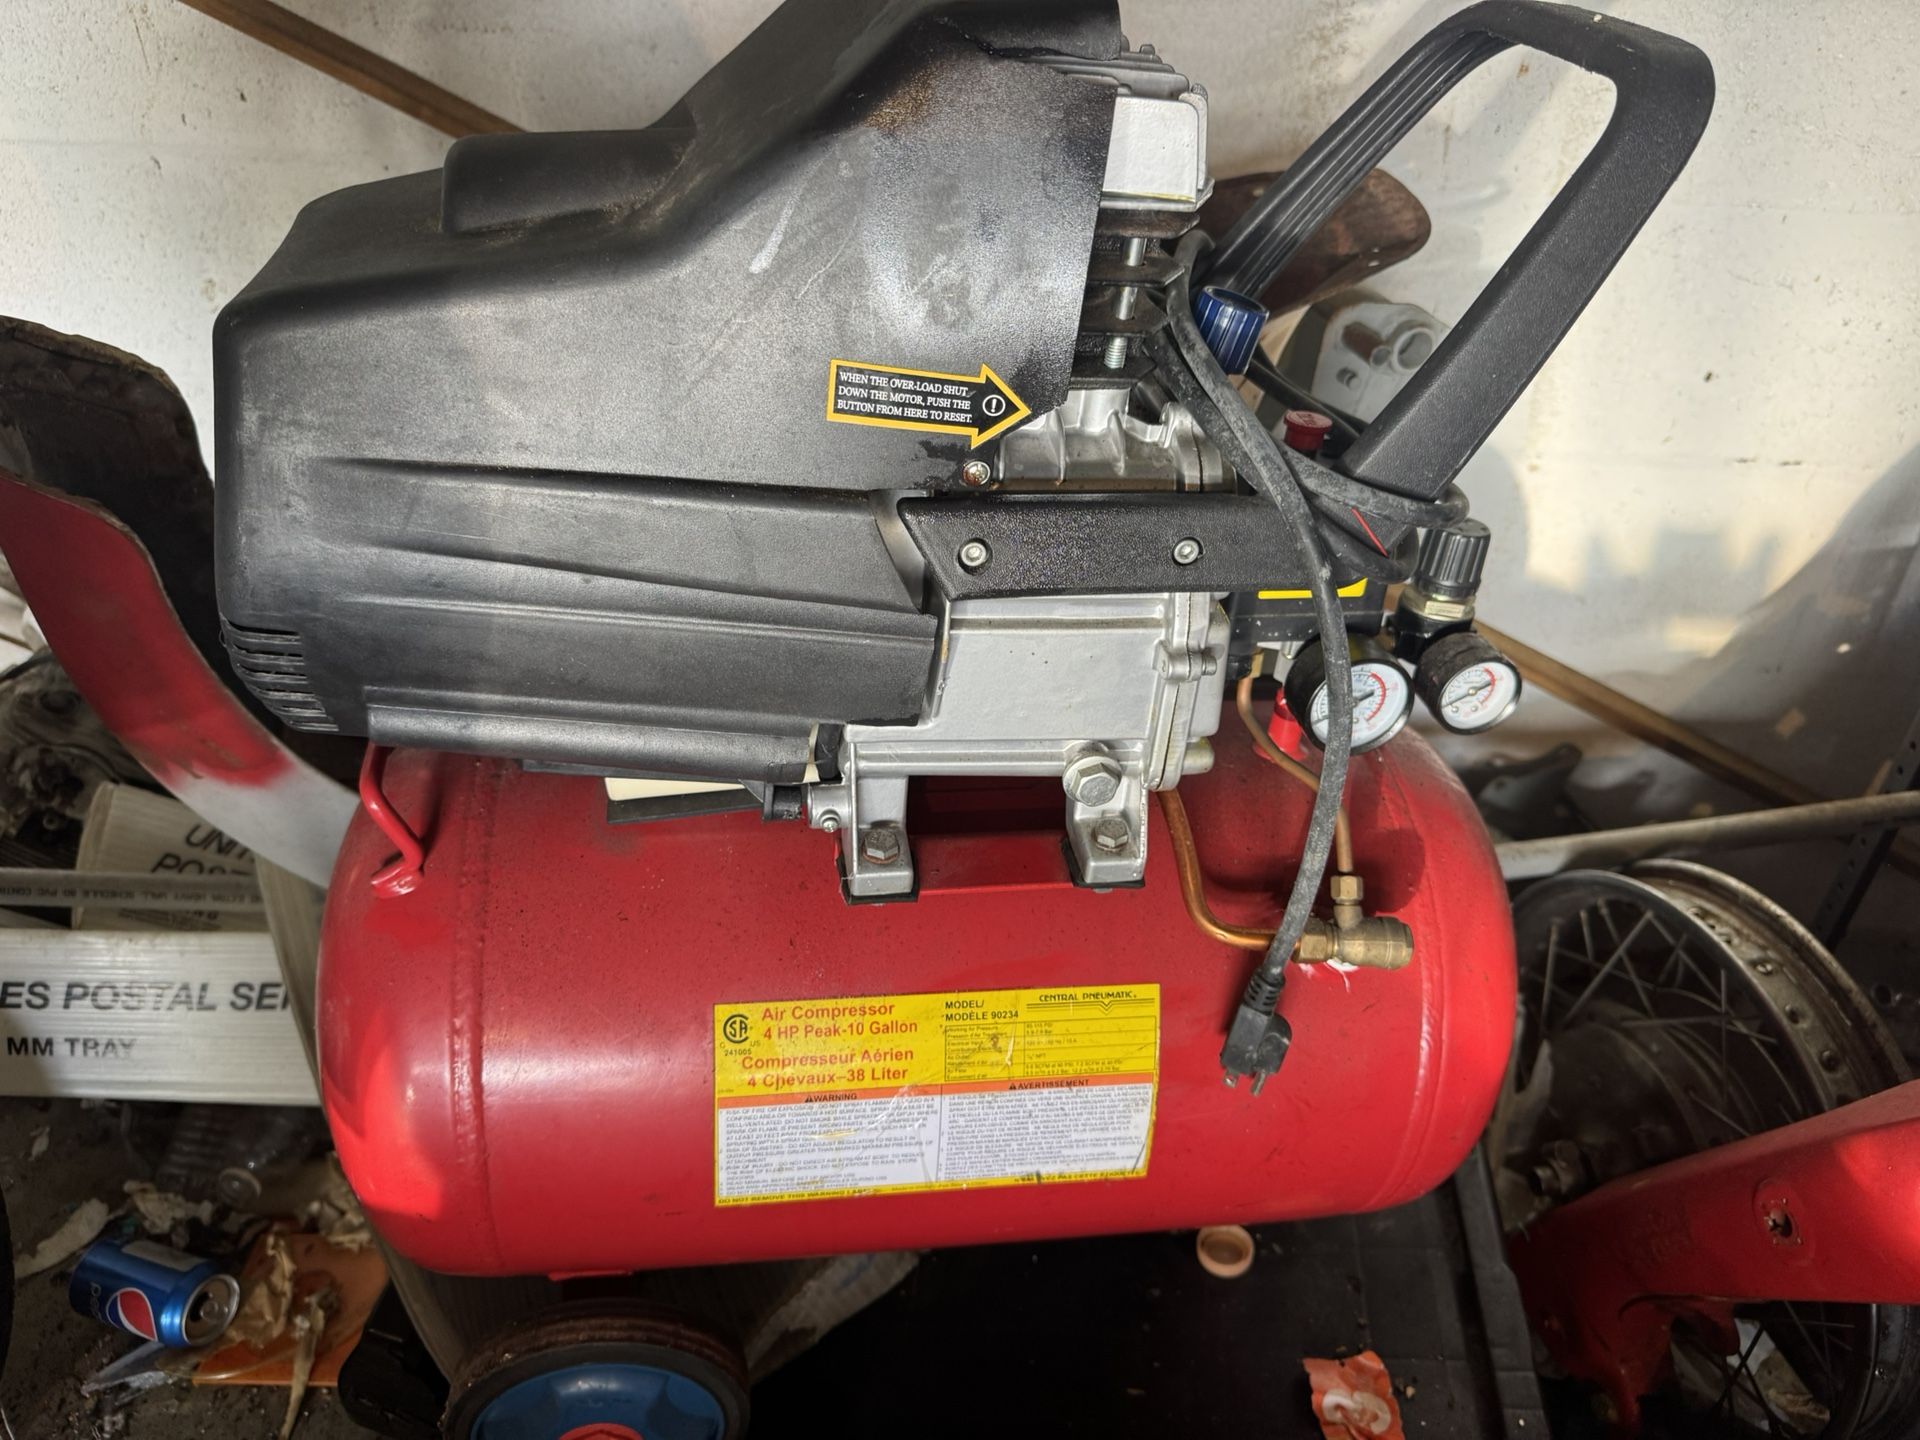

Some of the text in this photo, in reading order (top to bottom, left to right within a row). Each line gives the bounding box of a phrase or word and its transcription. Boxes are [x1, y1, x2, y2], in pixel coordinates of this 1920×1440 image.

[839, 371, 968, 396] WHEN THE OVER-LOAD SHUT
[838, 386, 970, 410] DOWN THE MOTOR, PUSH THE
[838, 400, 972, 423] BUTTON FROM HERE TO RESET.
[185, 825, 254, 863] UNIT
[63, 981, 217, 1011] POSTAL
[945, 1000, 984, 1009] MODEL/
[1039, 994, 1078, 1002] CENTRAL
[762, 1004, 895, 1021] Air Compressor
[992, 1011, 1019, 1019] 90234
[764, 1021, 918, 1040] 4 HP Peak-10 Gallon
[6, 1037, 137, 1057] MM TRAY
[742, 1049, 913, 1069] Compresseur Aérien
[748, 1075, 756, 1087] 4
[872, 1068, 908, 1081] Liter
[1018, 1079, 1089, 1091] AVERTISSEMENT
[813, 1093, 857, 1103] WARNING
